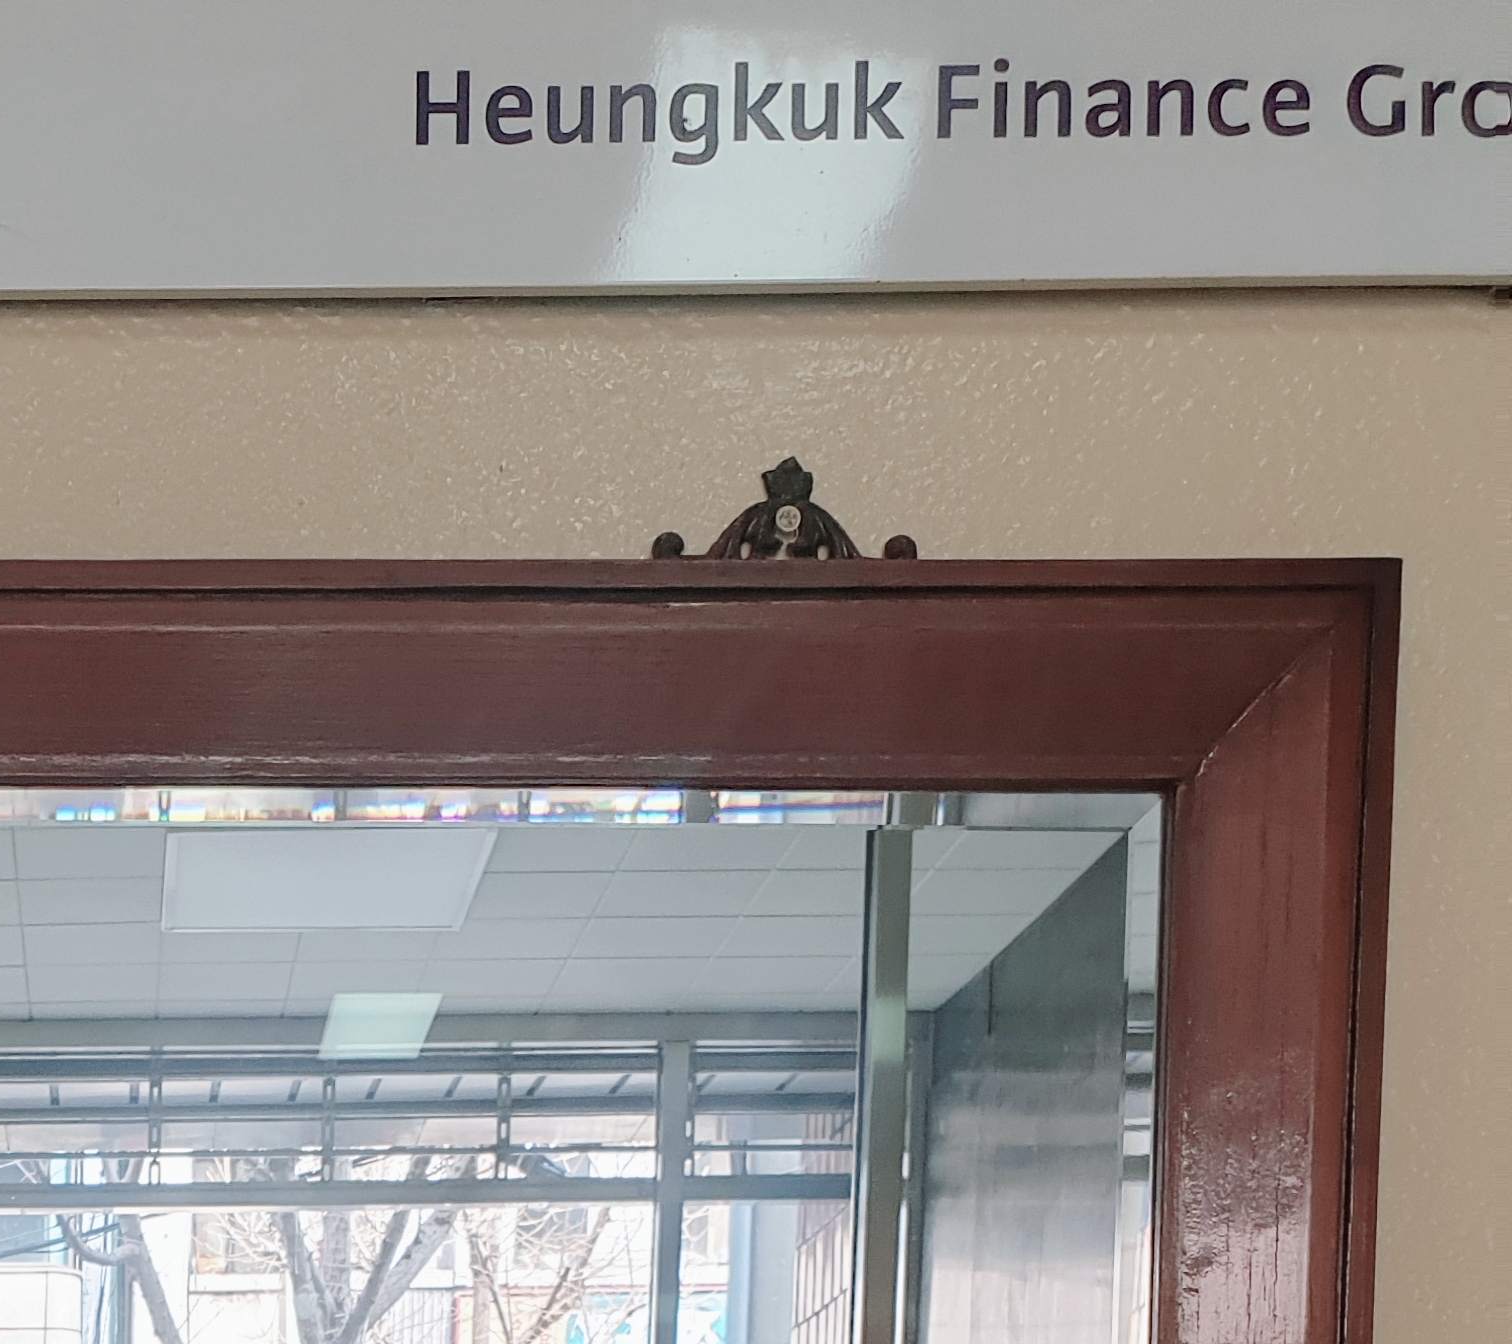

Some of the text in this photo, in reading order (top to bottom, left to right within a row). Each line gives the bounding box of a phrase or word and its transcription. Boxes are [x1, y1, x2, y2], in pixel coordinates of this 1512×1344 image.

[415, 58, 1512, 165] Heungkuk Finance Gro
